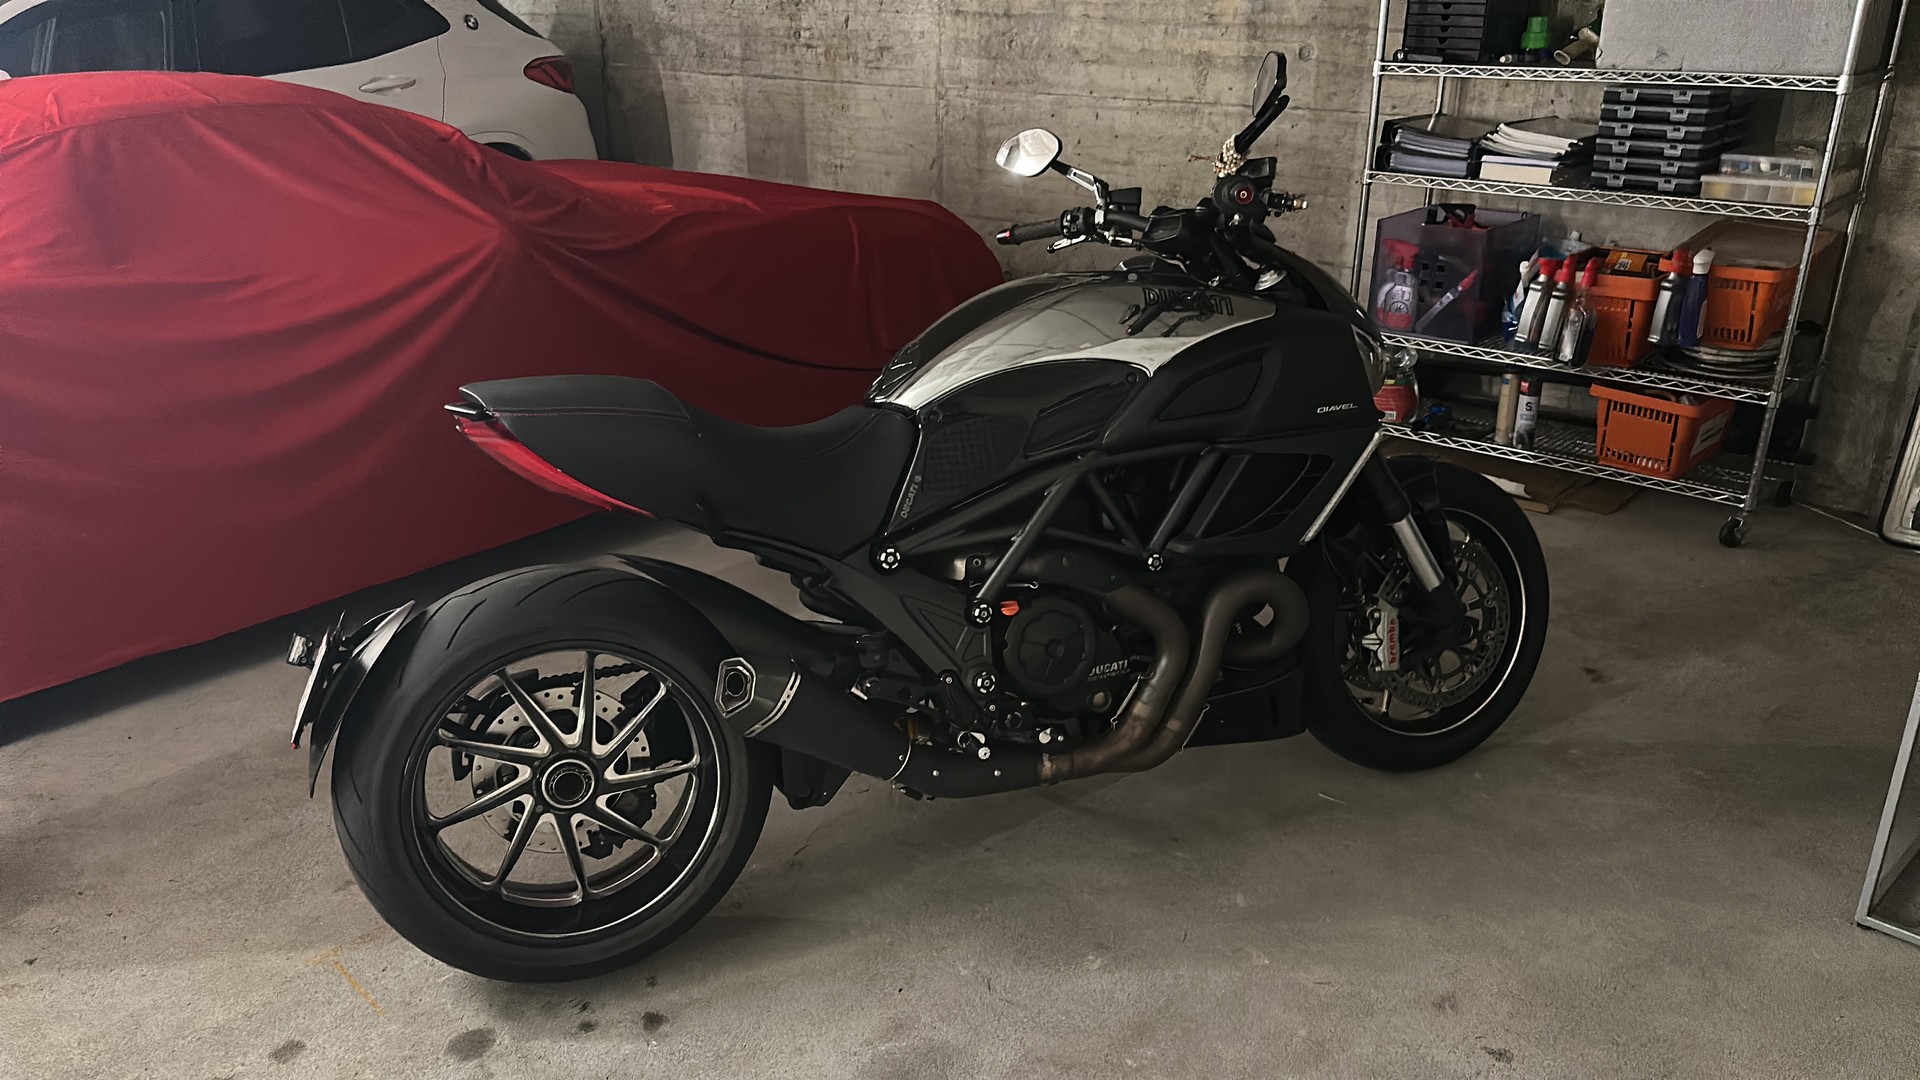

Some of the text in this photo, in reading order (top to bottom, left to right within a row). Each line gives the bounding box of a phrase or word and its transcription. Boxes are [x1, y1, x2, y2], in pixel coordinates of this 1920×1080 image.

[1142, 286, 1234, 317] DUTI
[1317, 402, 1358, 414] DIAVEL
[901, 483, 919, 519] DUCATI
